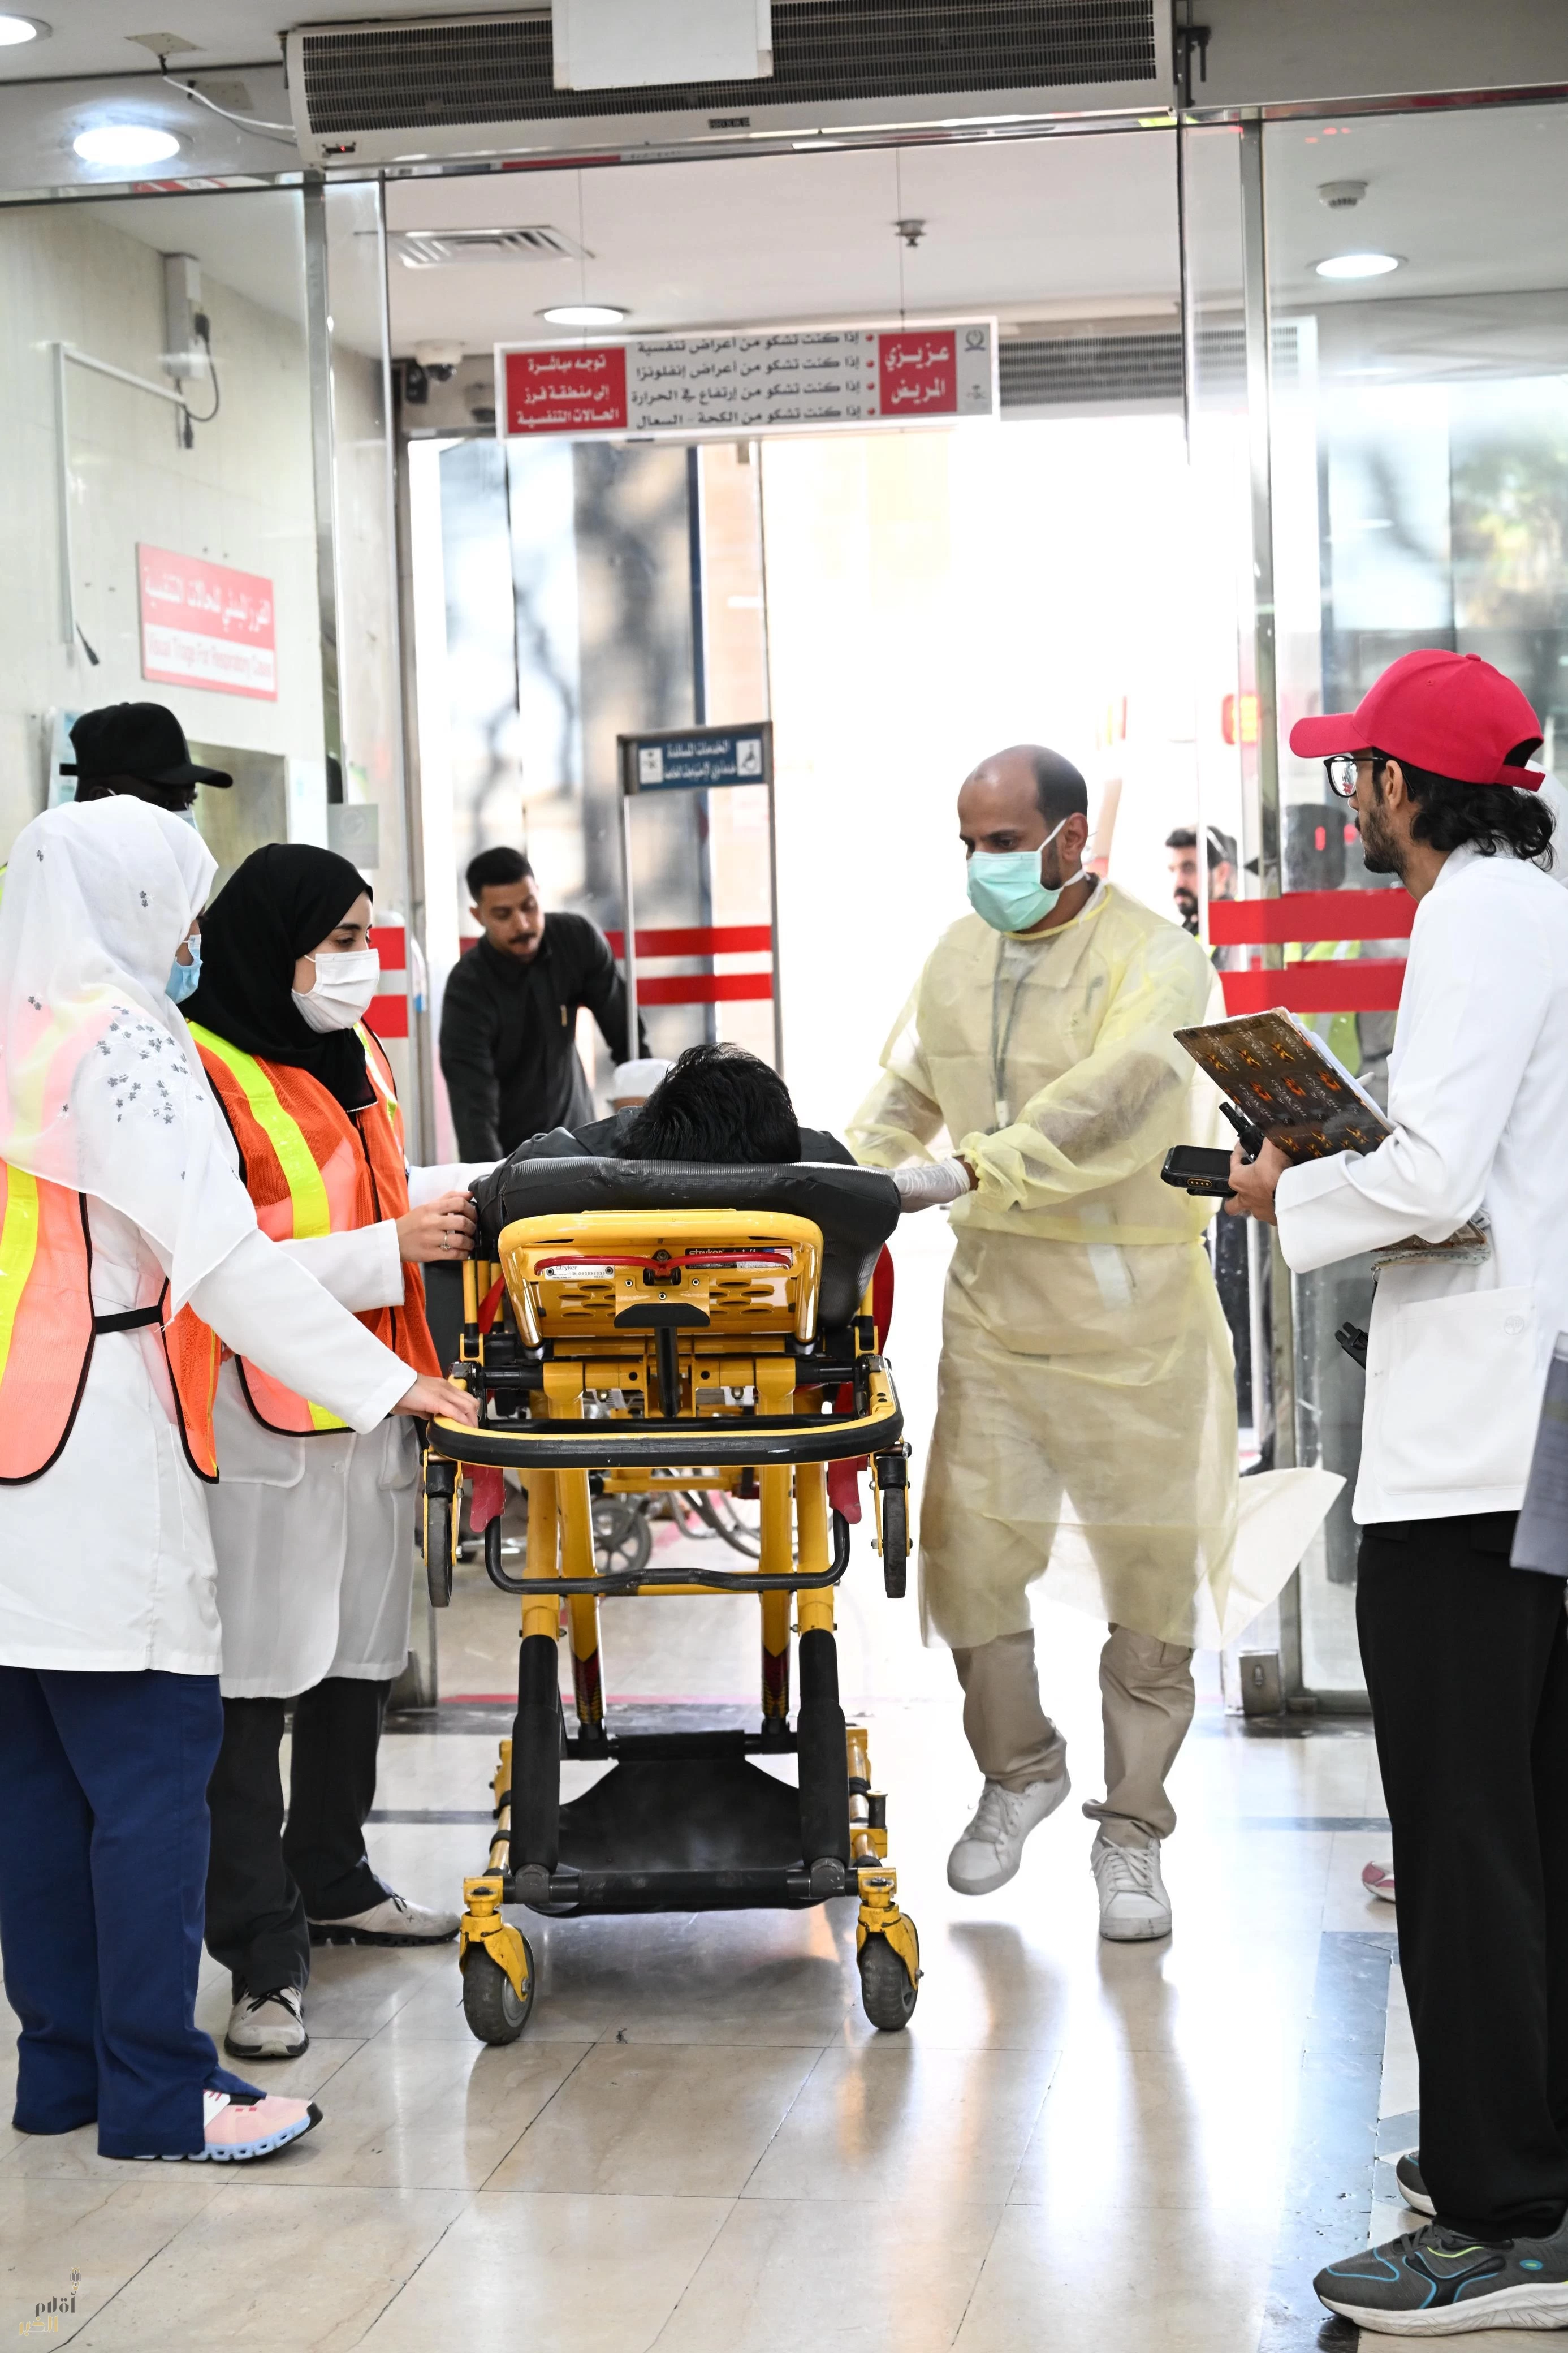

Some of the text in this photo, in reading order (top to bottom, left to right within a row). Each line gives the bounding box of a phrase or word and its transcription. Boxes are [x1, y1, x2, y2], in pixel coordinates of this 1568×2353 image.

[739, 338, 760, 352] من
[765, 334, 798, 350] تشكو
[801, 333, 839, 344] كنت
[844, 331, 859, 345] إذا
[637, 340, 686, 356] تنفسية
[802, 357, 840, 369] كنت
[845, 356, 860, 369] إذا
[885, 342, 950, 372] عزيزي
[527, 354, 607, 376] توجه مباشرة
[740, 363, 761, 376] من
[765, 358, 799, 375] تشكو
[548, 384, 593, 399] منطقة
[740, 387, 761, 400] من
[767, 382, 800, 399] تشكو
[803, 382, 841, 393] كنت
[845, 380, 861, 394] إذا
[891, 377, 945, 405] المريض
[524, 385, 547, 404] فرز
[631, 389, 678, 406] الحرارة
[516, 407, 620, 429] الحالات التنفسية
[698, 411, 738, 423] الكحة
[741, 412, 762, 425] من
[767, 407, 800, 424] تشكو
[804, 406, 841, 418] كنت
[846, 405, 861, 419] إذا
[636, 414, 683, 429] السعال
